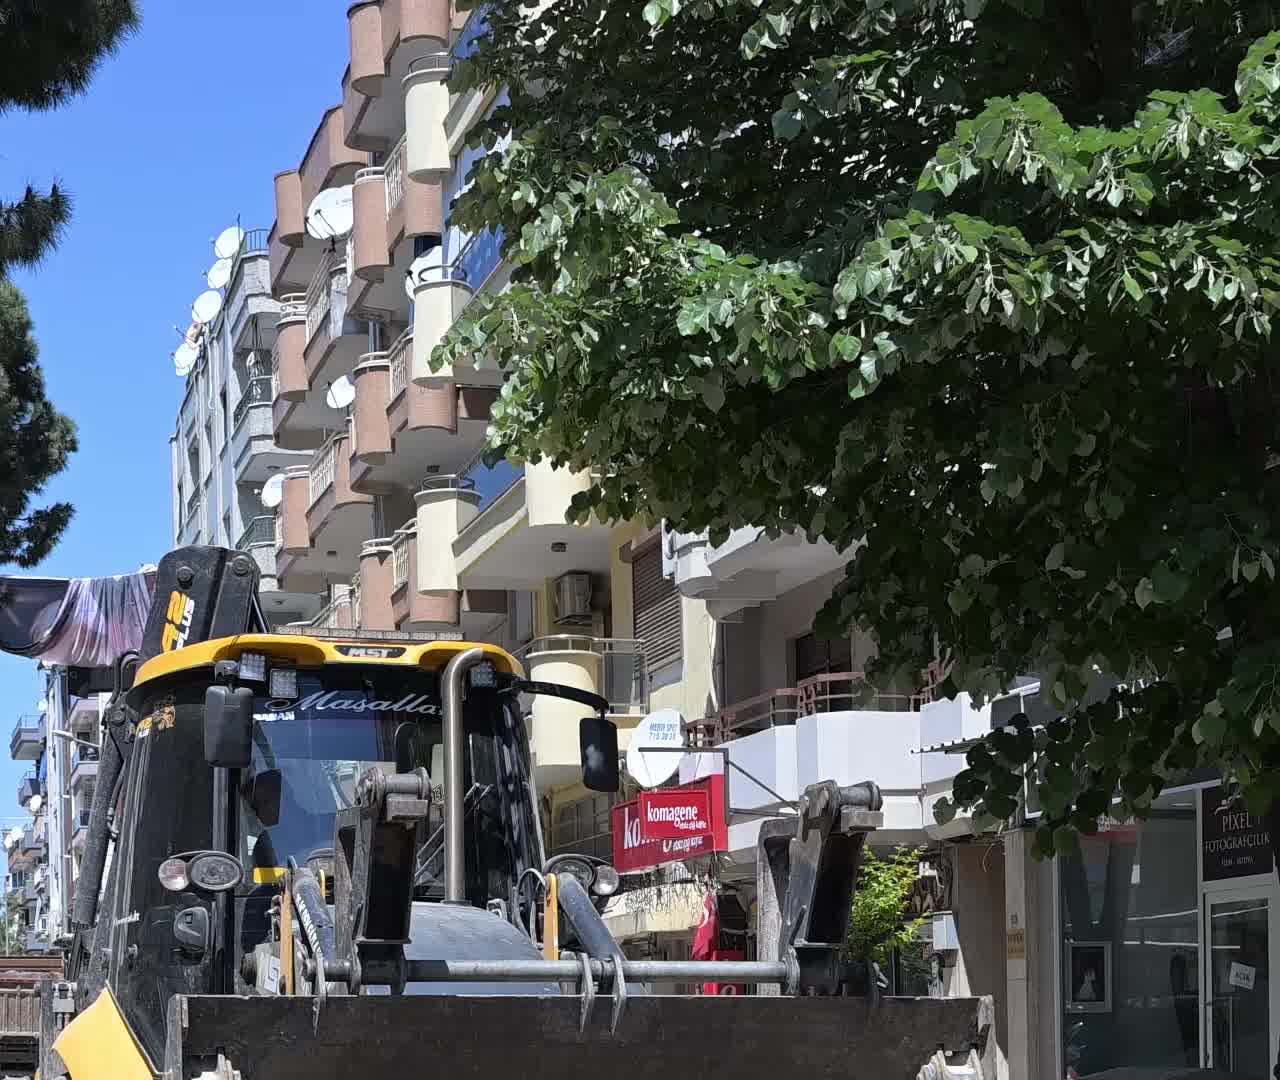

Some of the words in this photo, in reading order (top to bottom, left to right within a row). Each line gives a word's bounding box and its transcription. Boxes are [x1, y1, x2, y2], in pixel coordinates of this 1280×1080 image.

[347, 648, 393, 658] MST
[265, 690, 442, 716] Maşalla
[647, 801, 698, 827] komagene
